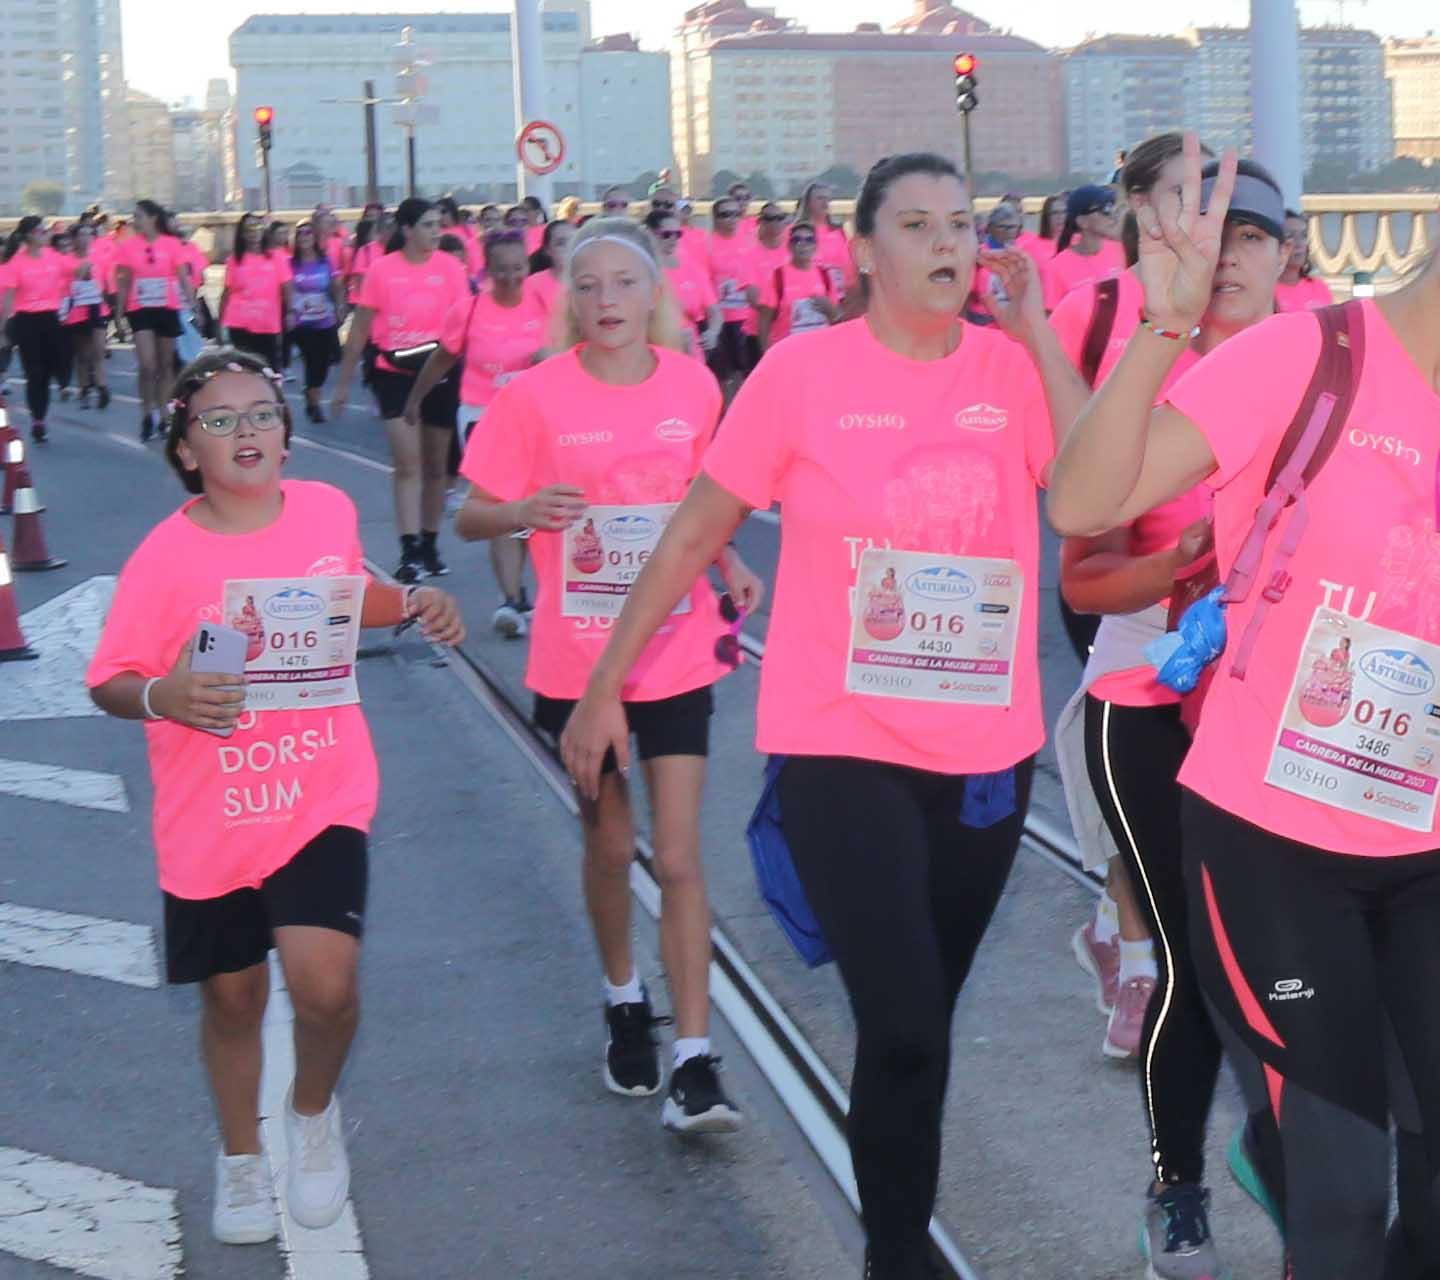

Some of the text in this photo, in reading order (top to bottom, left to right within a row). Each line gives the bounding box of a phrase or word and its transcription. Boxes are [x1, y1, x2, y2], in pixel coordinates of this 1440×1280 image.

[839, 413, 905, 431] OYSHO
[558, 429, 614, 448] OYSHO
[912, 576, 971, 595] ASTURIANA
[909, 611, 966, 635] 016
[271, 631, 318, 649] 016
[917, 639, 953, 654] 4430
[868, 653, 914, 665] CARRERA
[914, 657, 929, 667] DE
[929, 658, 943, 668] LA
[861, 673, 912, 688] OYSHO
[1353, 699, 1412, 737] 016
[217, 716, 339, 774] DORSL
[1295, 738, 1347, 765] CARRERA
[1346, 757, 1362, 770] DE
[1362, 760, 1376, 773] LA
[1355, 735, 1391, 757] 3486
[1284, 760, 1339, 791] OYSHO
[223, 777, 304, 817] SUM
[1375, 791, 1421, 815] Santander
